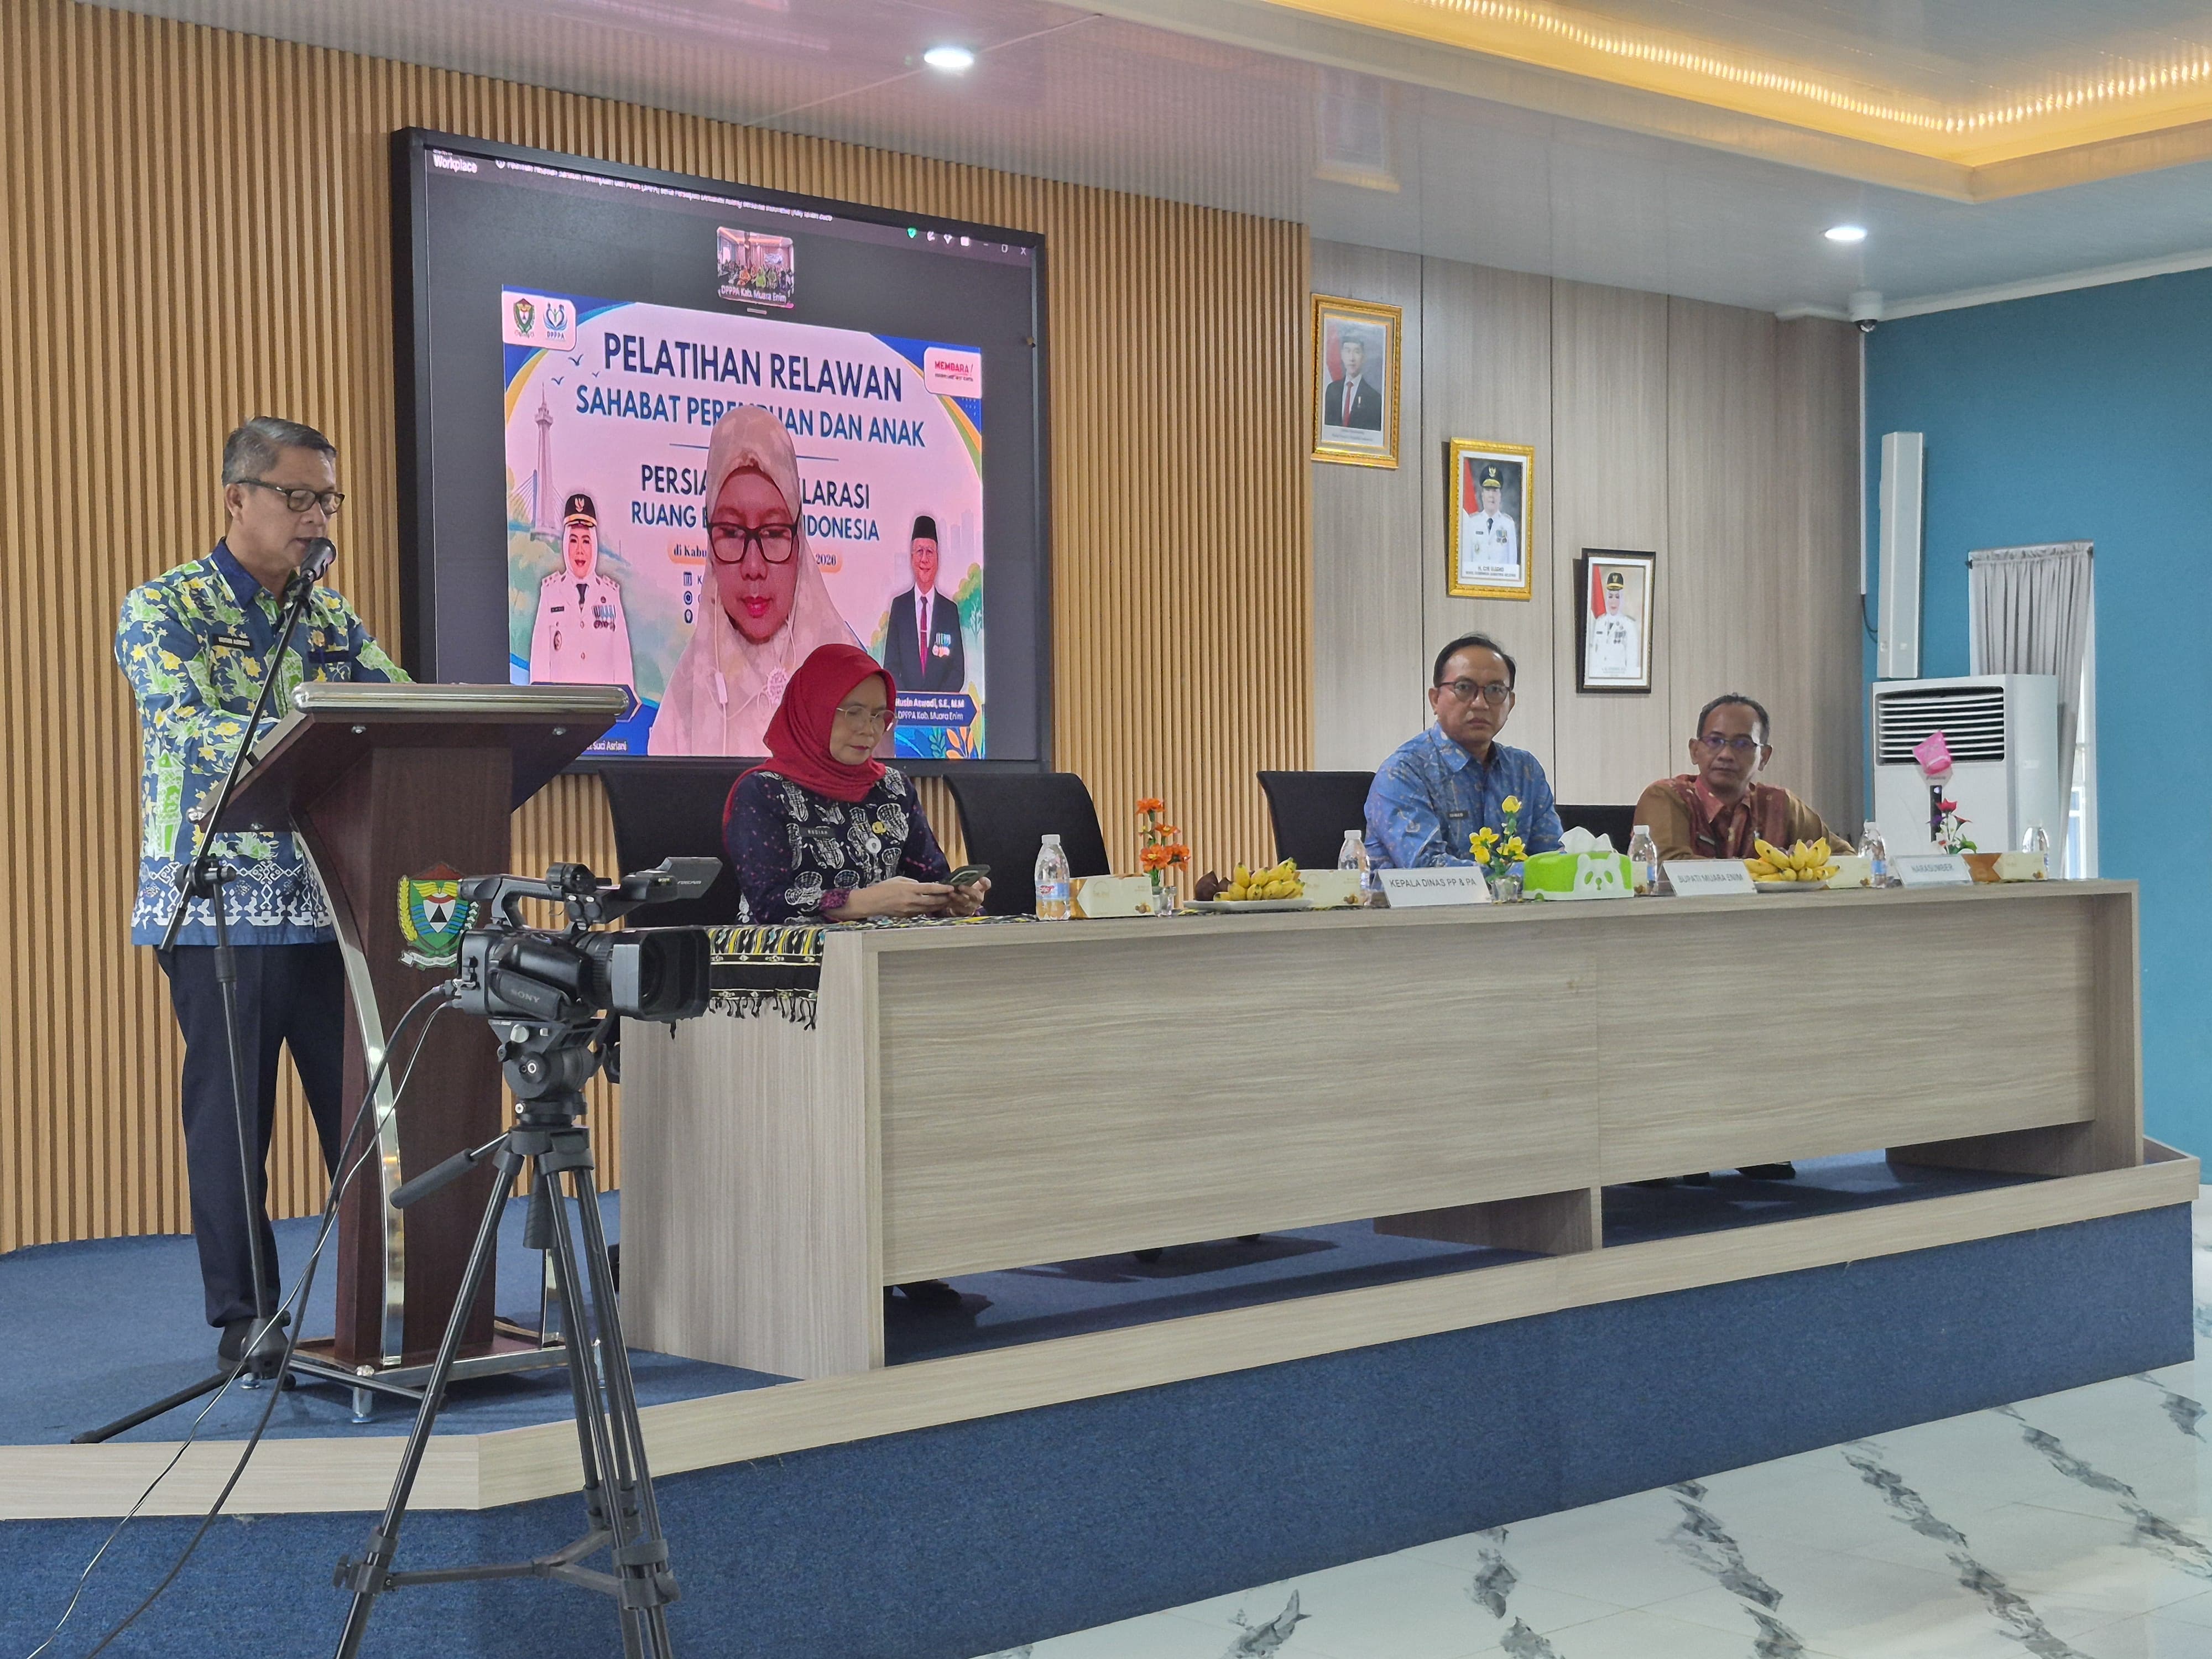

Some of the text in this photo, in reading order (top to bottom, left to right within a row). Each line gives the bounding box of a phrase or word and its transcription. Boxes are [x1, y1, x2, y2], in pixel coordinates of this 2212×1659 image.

[433, 154, 477, 173] Workplace
[753, 290, 771, 300] Muara
[604, 332, 901, 402] PELATIHAN RELAWAN
[576, 385, 925, 447] SAHABAT PERAN DAN ANAK
[632, 500, 697, 528] RUANG
[803, 514, 880, 541] DONESIA
[674, 544, 682, 556] di
[1389, 879, 1421, 888] KEPALA
[1422, 878, 1446, 886] DINAS
[1447, 878, 1457, 886] PP
[1459, 878, 1465, 886] &
[1677, 875, 1701, 883] BUPATI
